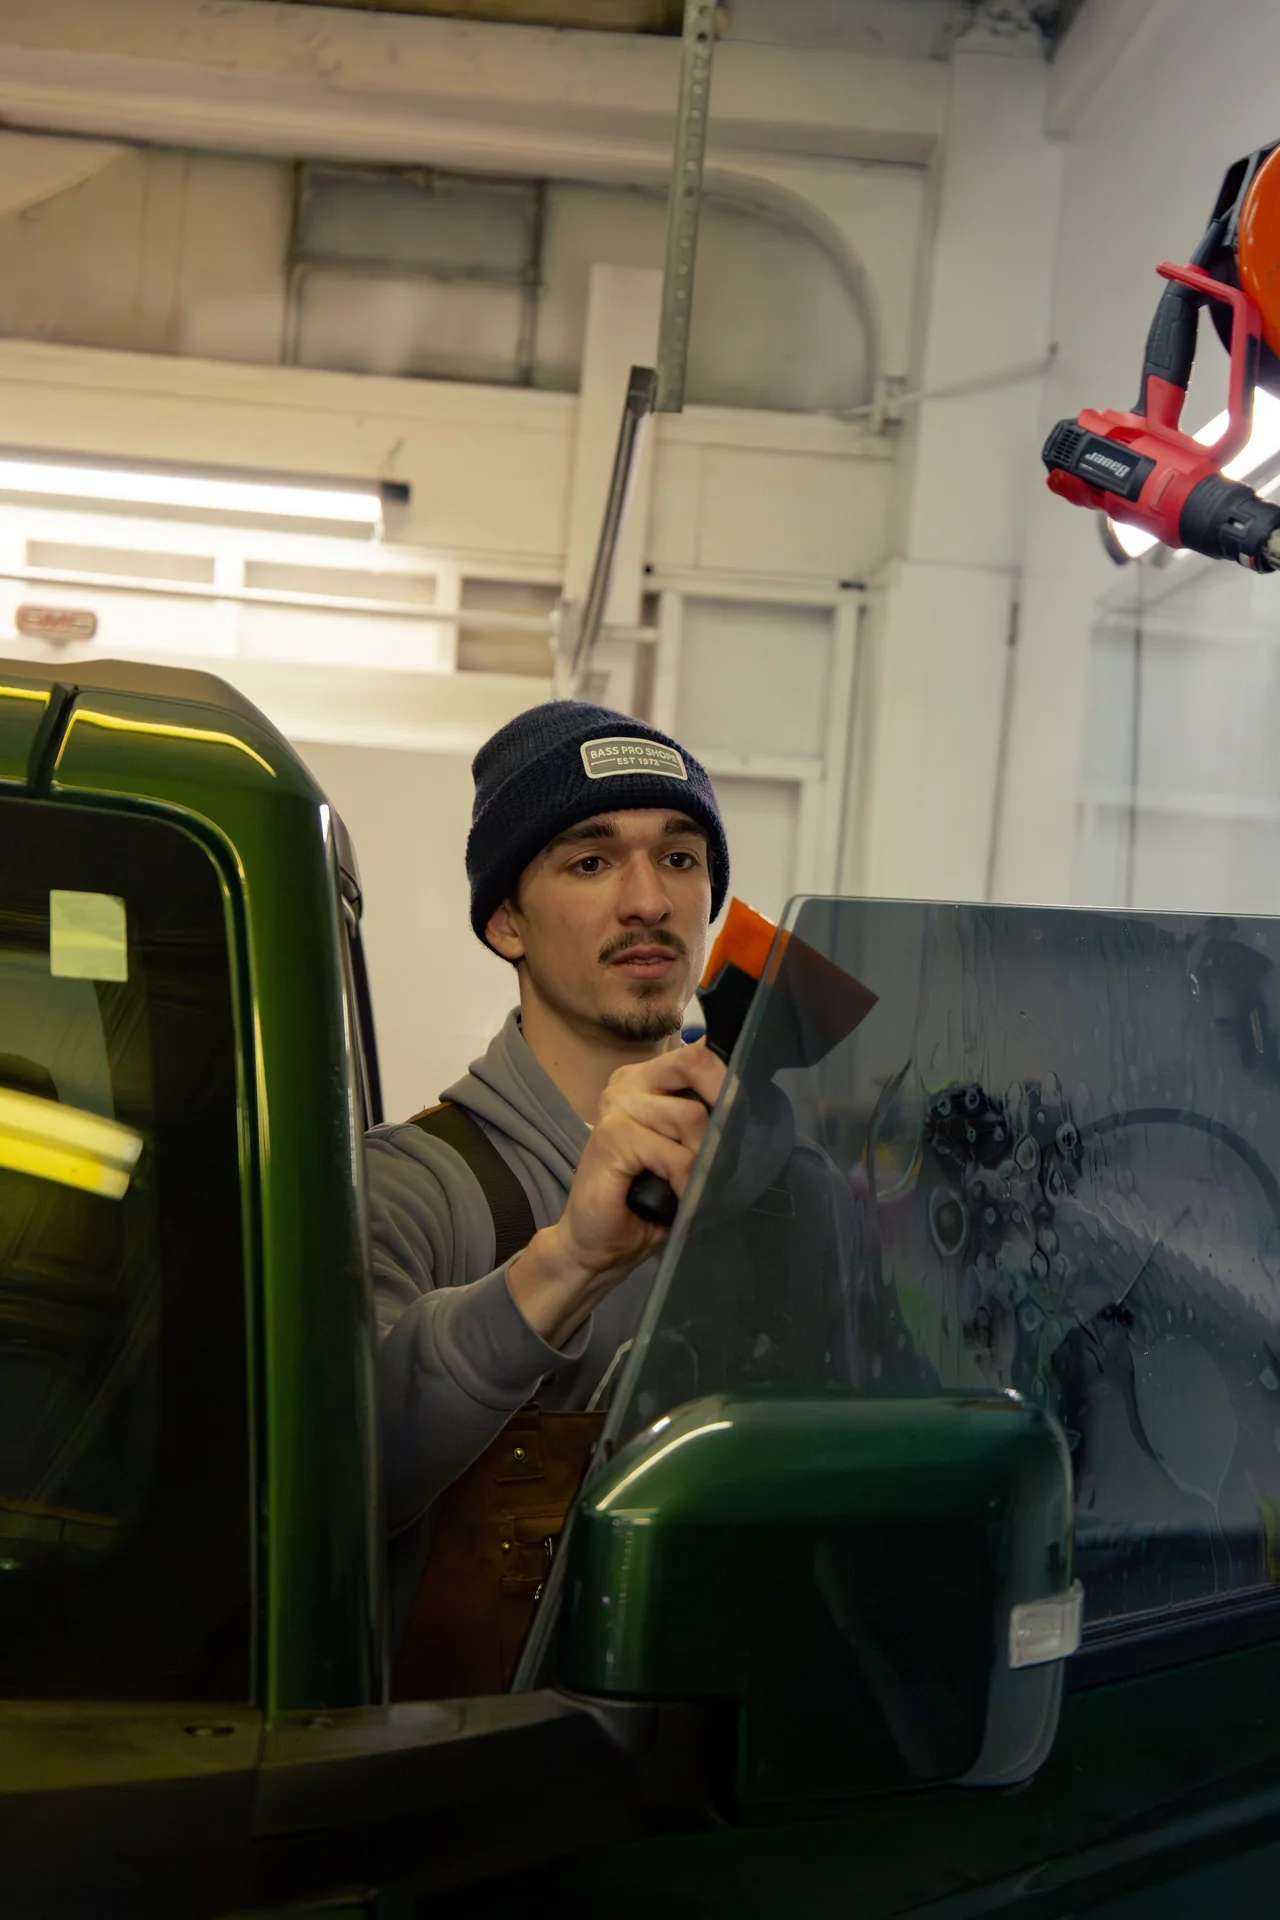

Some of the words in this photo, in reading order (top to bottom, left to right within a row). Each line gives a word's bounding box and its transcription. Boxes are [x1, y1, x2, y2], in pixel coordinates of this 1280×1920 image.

[590, 746, 619, 760] BASS
[621, 745, 644, 755] PRO
[645, 747, 678, 763] SHOPS
[617, 757, 635, 765] EST
[638, 758, 660, 767] 1972
